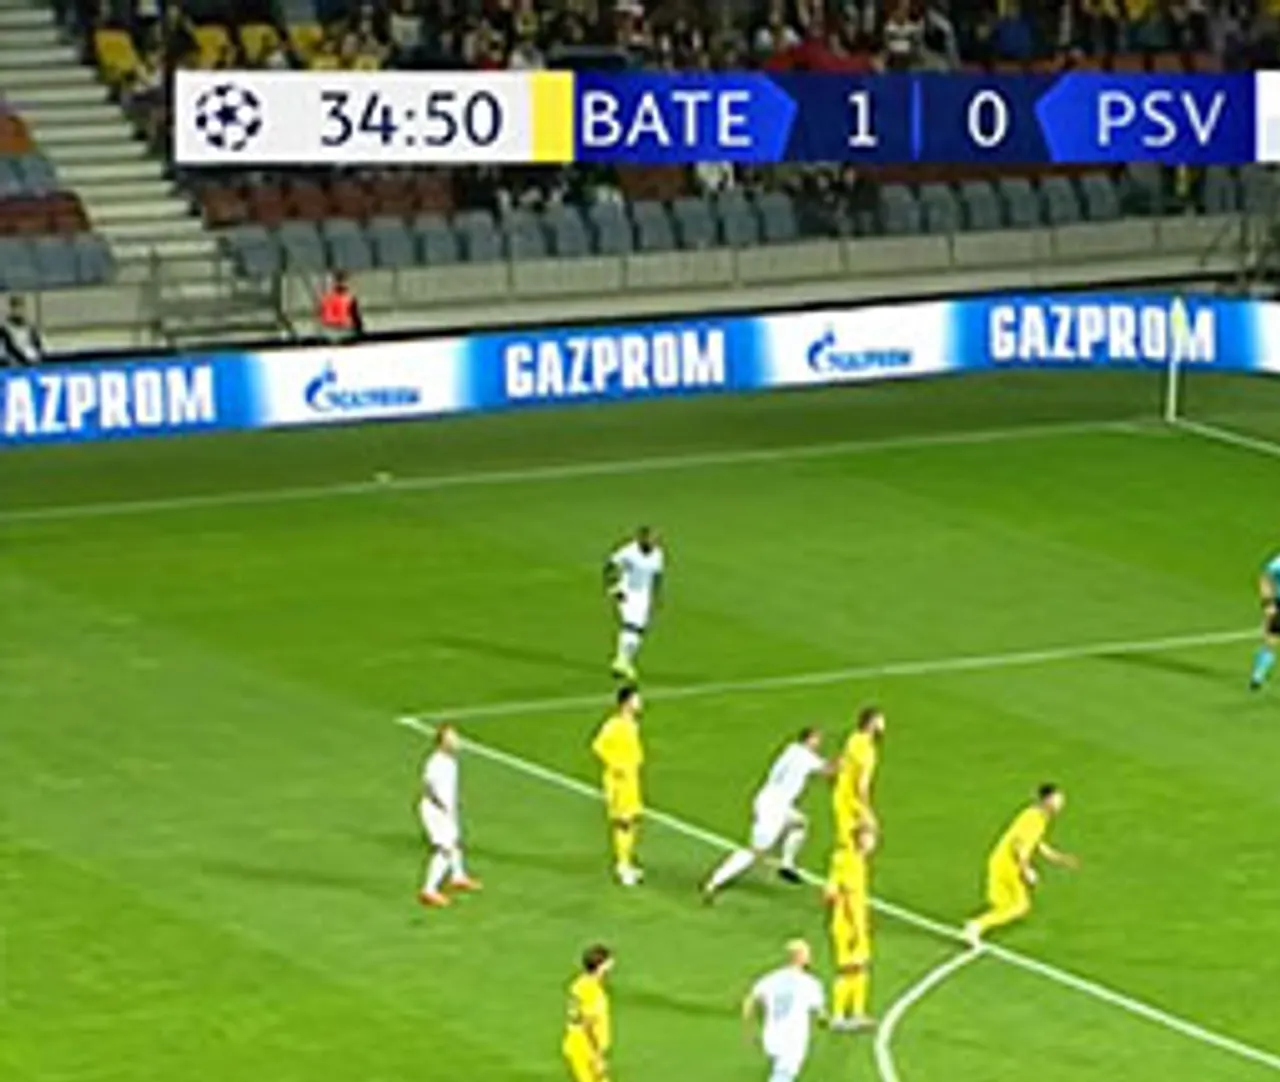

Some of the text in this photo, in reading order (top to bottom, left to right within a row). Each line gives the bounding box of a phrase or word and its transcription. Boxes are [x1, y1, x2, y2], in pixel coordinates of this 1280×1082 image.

[504, 329, 726, 398] GAZPROM
[988, 303, 1217, 363] GAZPROM
[4, 364, 217, 437] AZPROM
